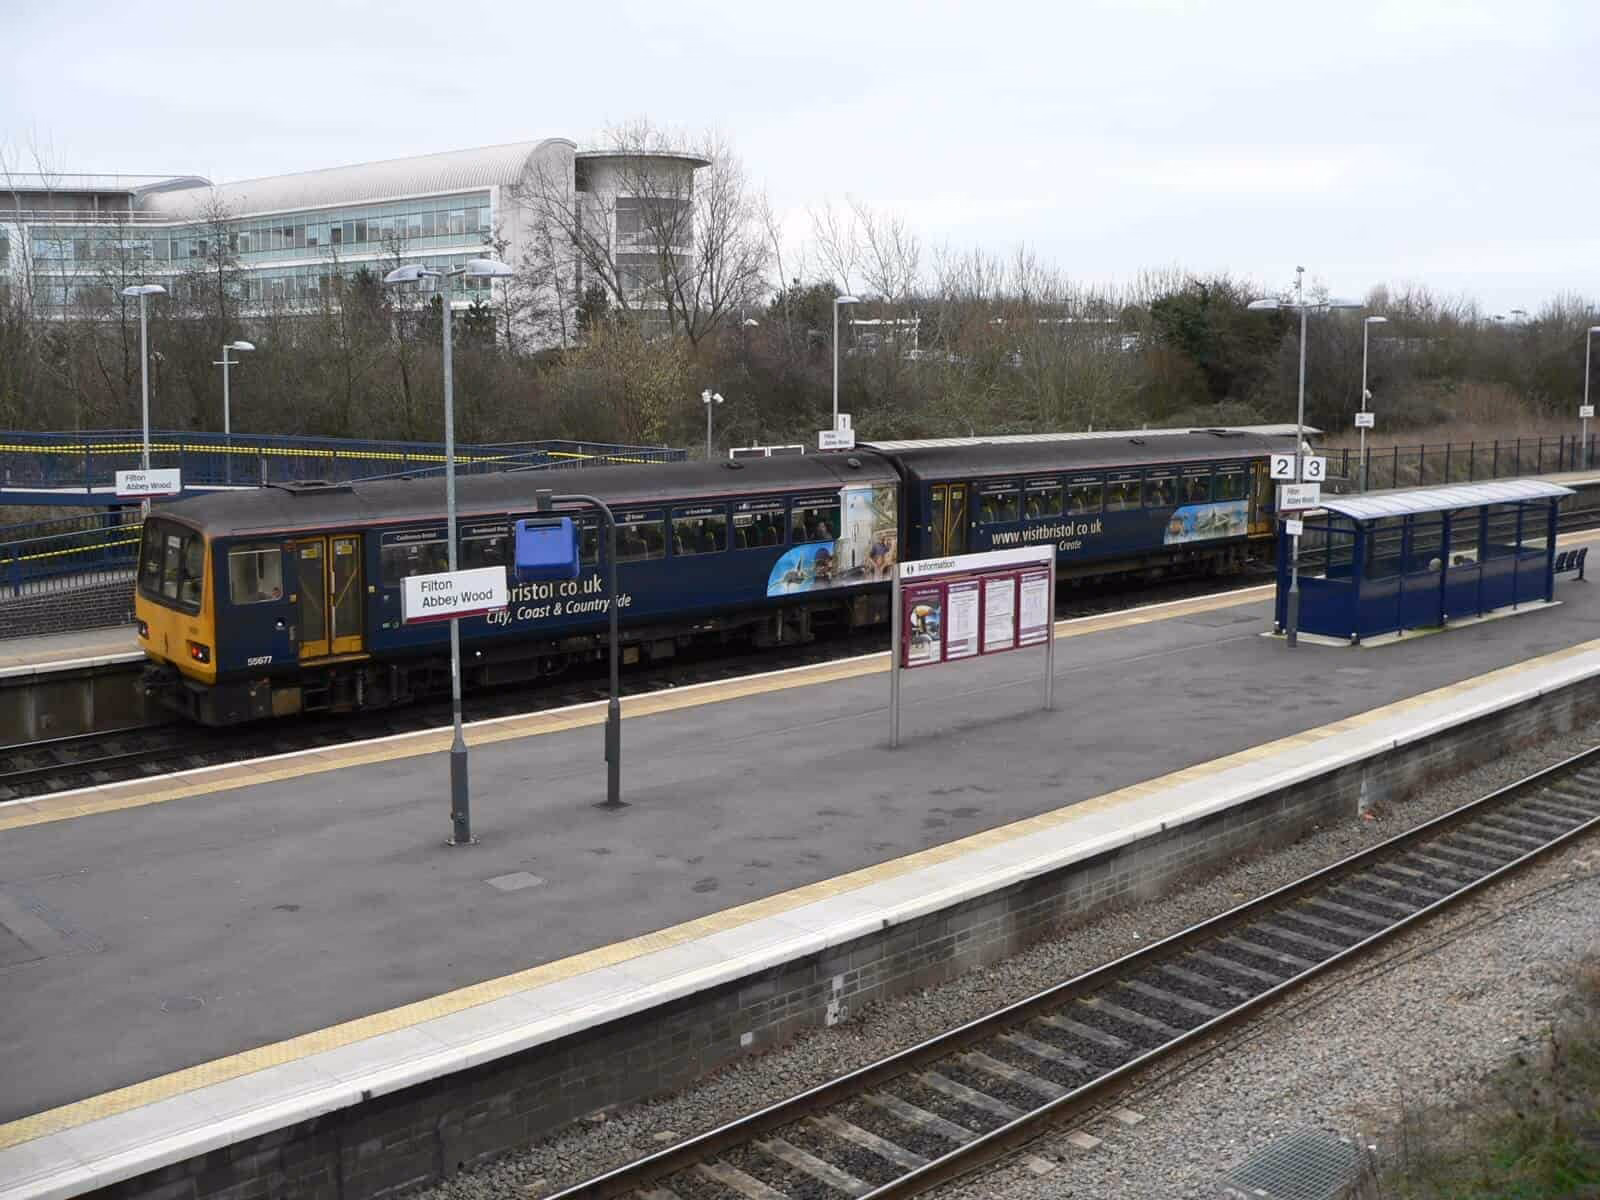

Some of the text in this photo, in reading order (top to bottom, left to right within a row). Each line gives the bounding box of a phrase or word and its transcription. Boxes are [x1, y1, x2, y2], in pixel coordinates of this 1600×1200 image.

[1277, 458, 1289, 475] 2
[1309, 460, 1320, 477] 3
[918, 560, 955, 571] Information
[421, 580, 453, 592] Filton
[422, 589, 493, 608] Abbey Wood
[517, 606, 550, 620] Coast
[553, 602, 562, 615] &
[566, 593, 632, 613] Countryide
[247, 656, 272, 666] 55677
